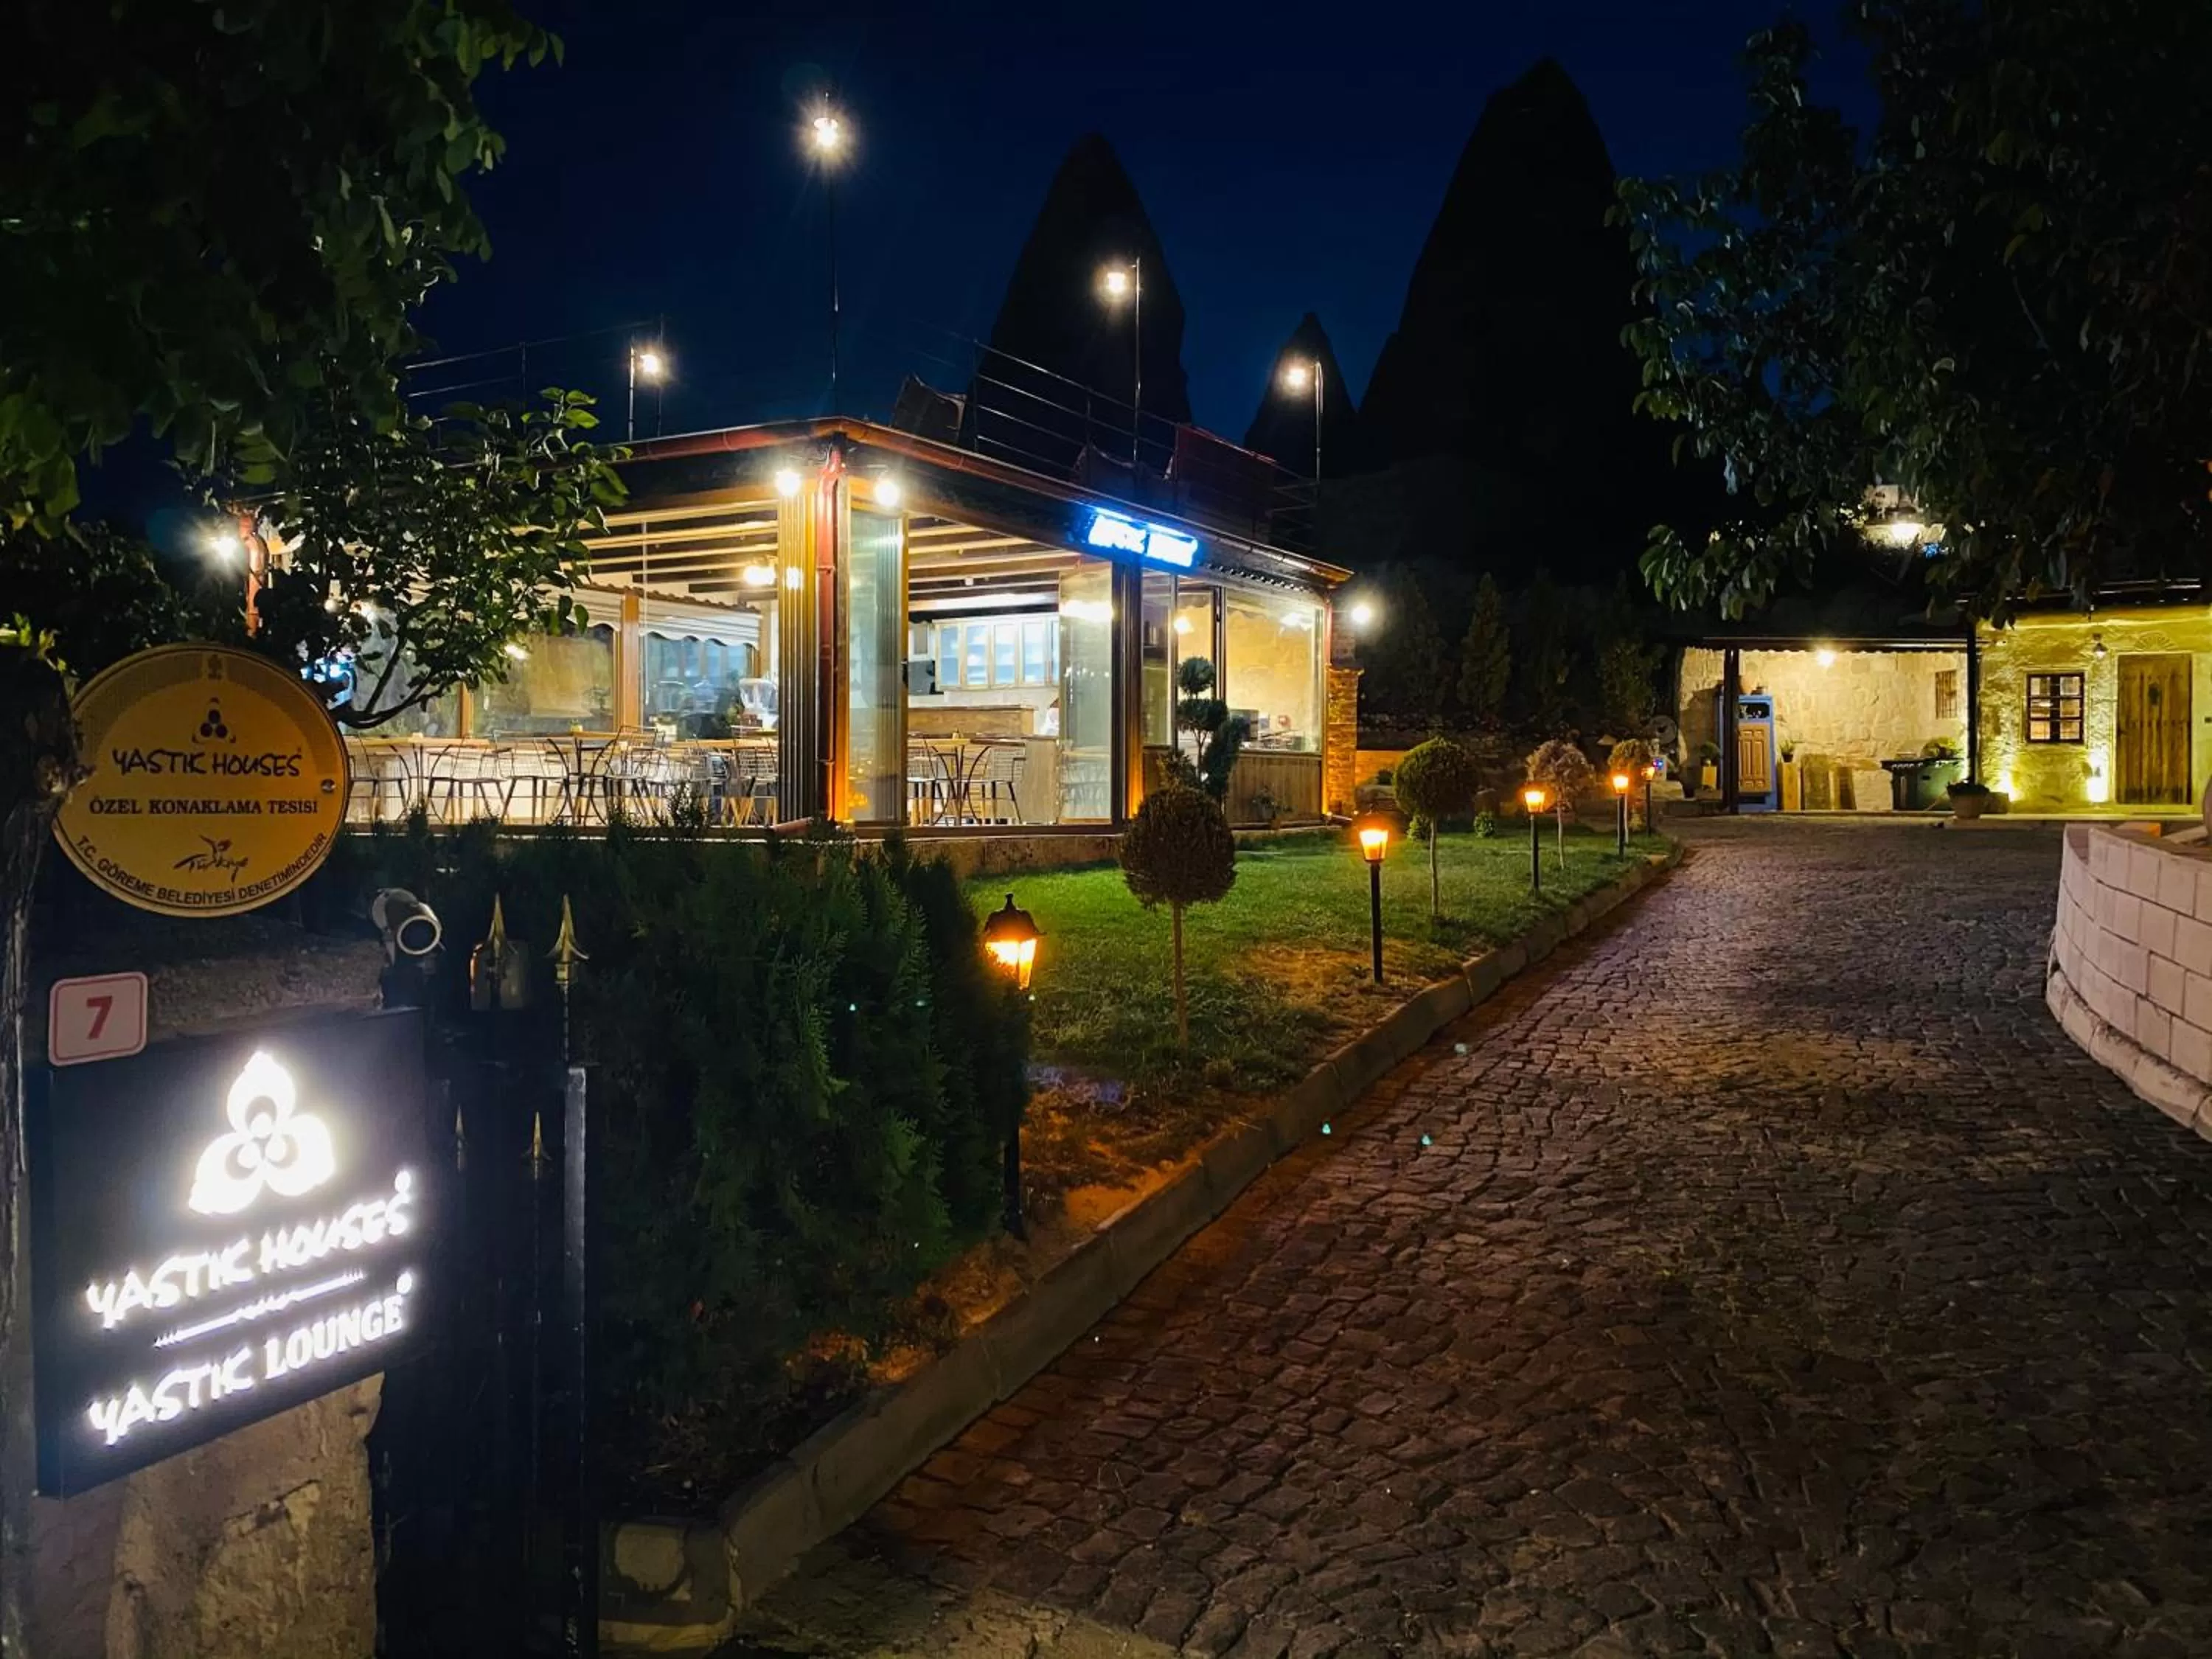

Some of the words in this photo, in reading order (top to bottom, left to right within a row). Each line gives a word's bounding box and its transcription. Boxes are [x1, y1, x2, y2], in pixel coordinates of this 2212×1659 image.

[213, 752, 302, 776] HOUSES
[89, 796, 142, 815] ÖZEL
[149, 799, 261, 815] KONAKLAMA
[97, 858, 155, 897] GÖREME
[158, 886, 235, 903] BELEDİYESİ
[86, 996, 114, 1040] 7
[265, 1295, 403, 1380] LOUNGE
